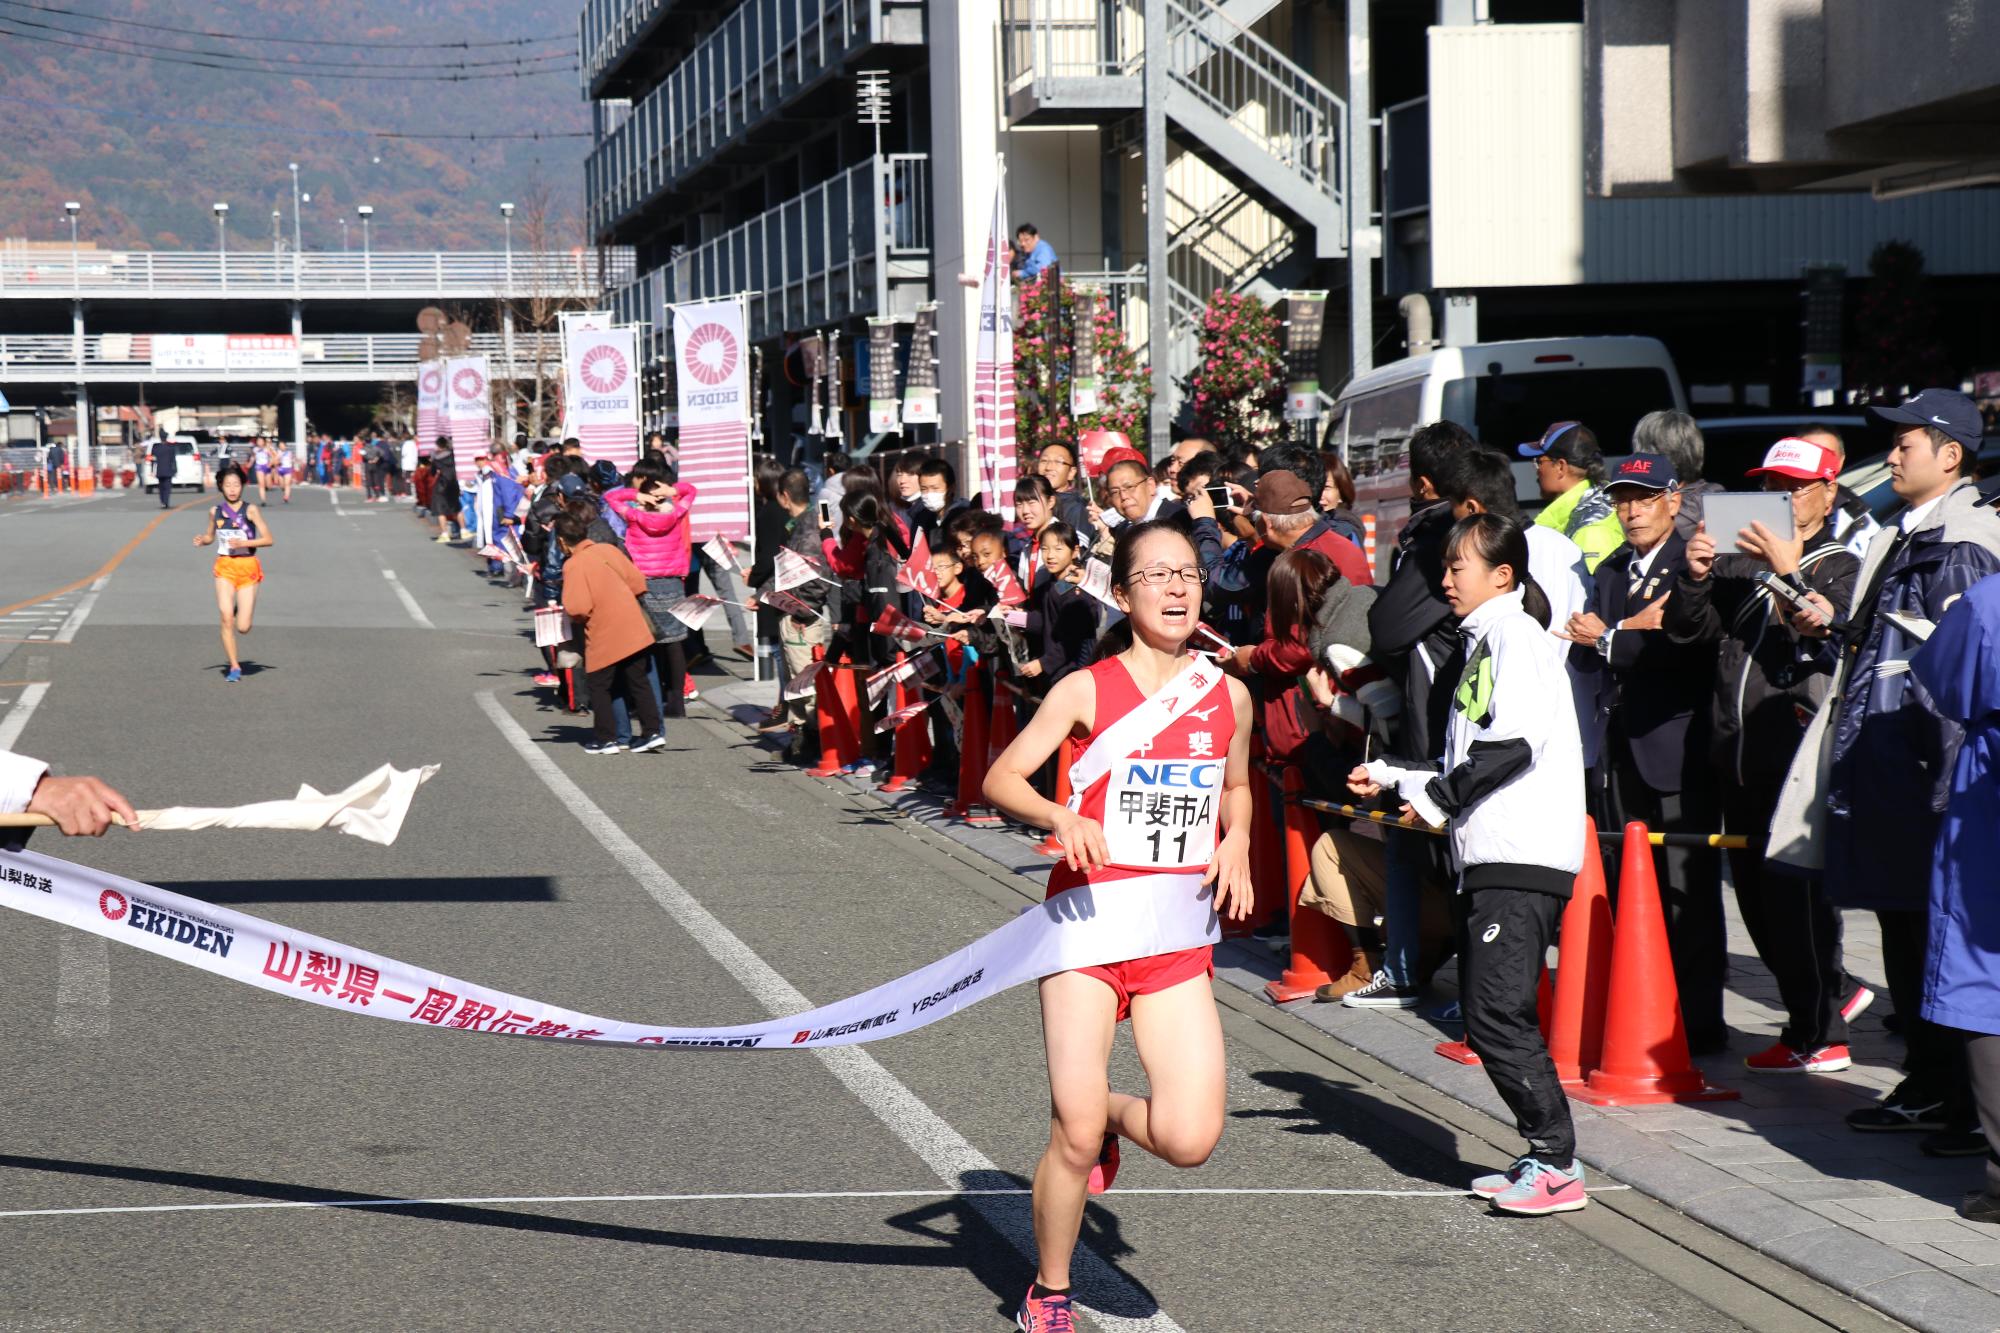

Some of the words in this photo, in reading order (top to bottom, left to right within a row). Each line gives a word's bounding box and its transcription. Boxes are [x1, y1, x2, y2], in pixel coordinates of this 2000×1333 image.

[1126, 764, 1217, 789] NEC
[1119, 790, 1211, 828] 甲斐市A
[1146, 829, 1188, 863] 11
[127, 903, 234, 958] EKIDEN
[168, 908, 184, 919] THE
[187, 914, 235, 934] YAMANASHI
[911, 967, 985, 1015] YBS山梨放送
[807, 1008, 900, 1042] 山梨日日新聞社
